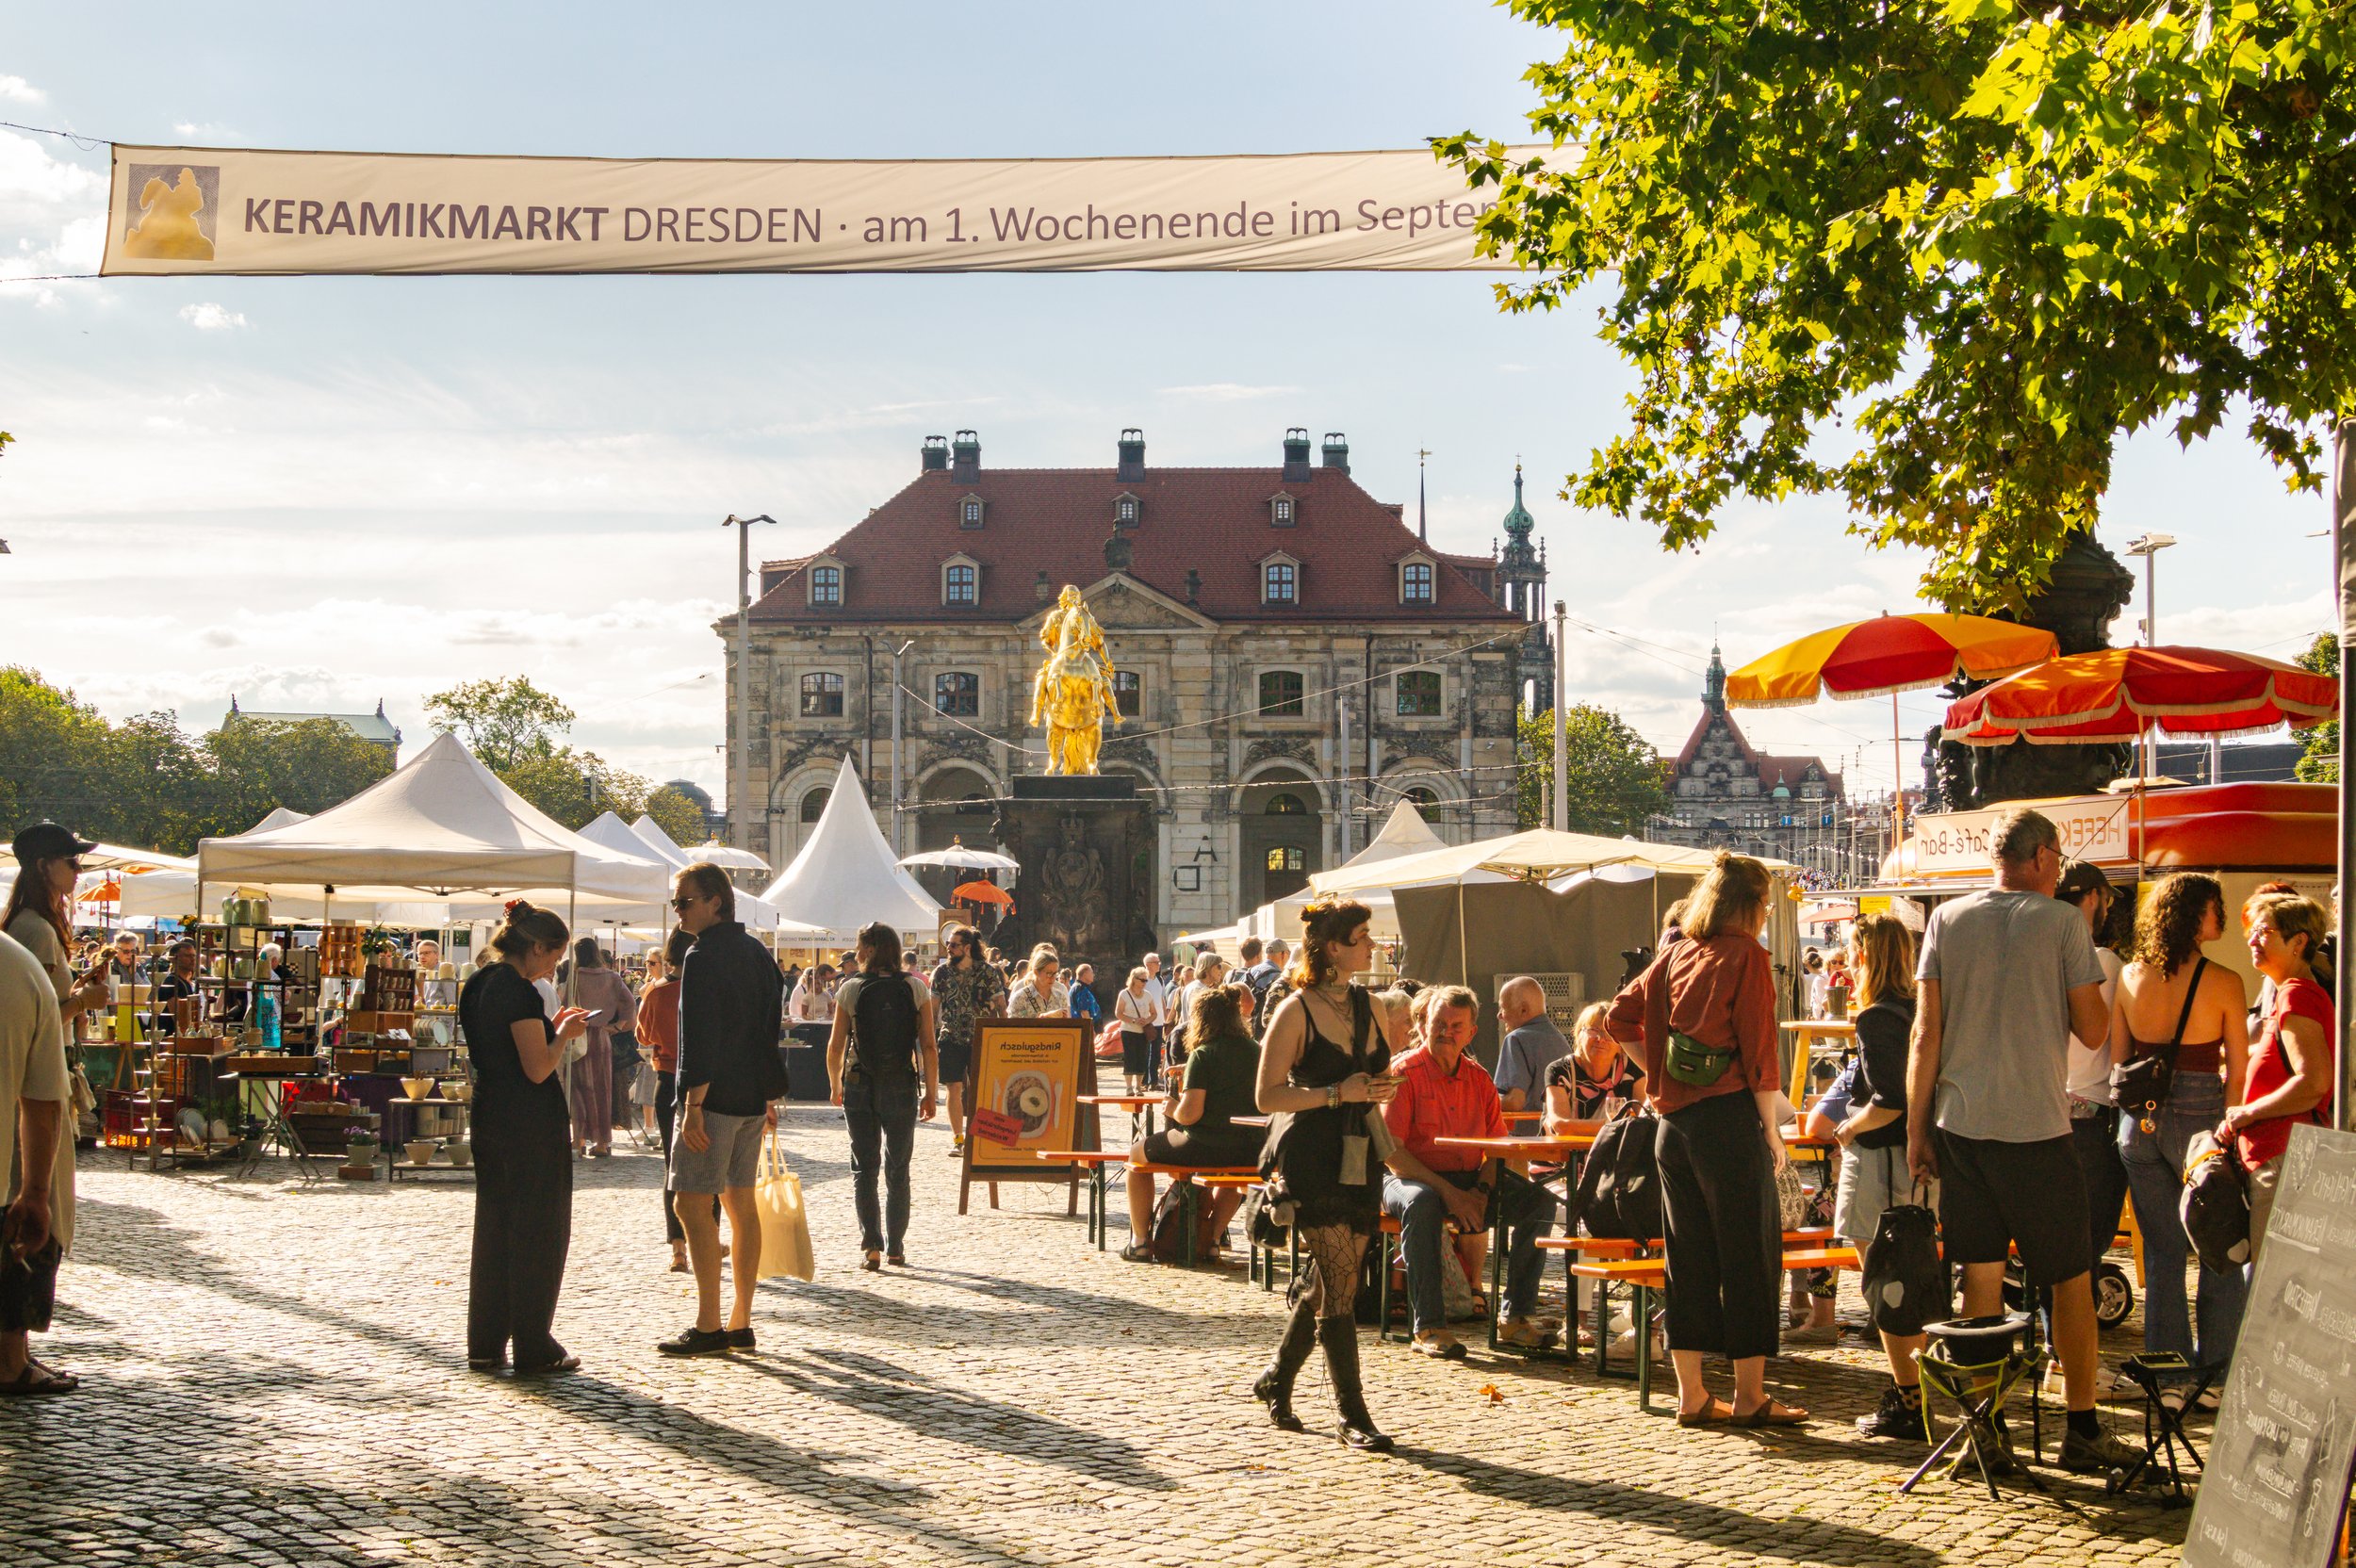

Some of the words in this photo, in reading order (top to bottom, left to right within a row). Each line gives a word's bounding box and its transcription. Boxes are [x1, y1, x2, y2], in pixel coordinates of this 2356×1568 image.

[245, 198, 609, 241] KERAMIKMARKT
[625, 207, 820, 243] DRESDEN
[864, 217, 927, 243] am
[946, 207, 979, 243] 1.
[990, 201, 1273, 243] Wochenende
[1292, 202, 1340, 236] im
